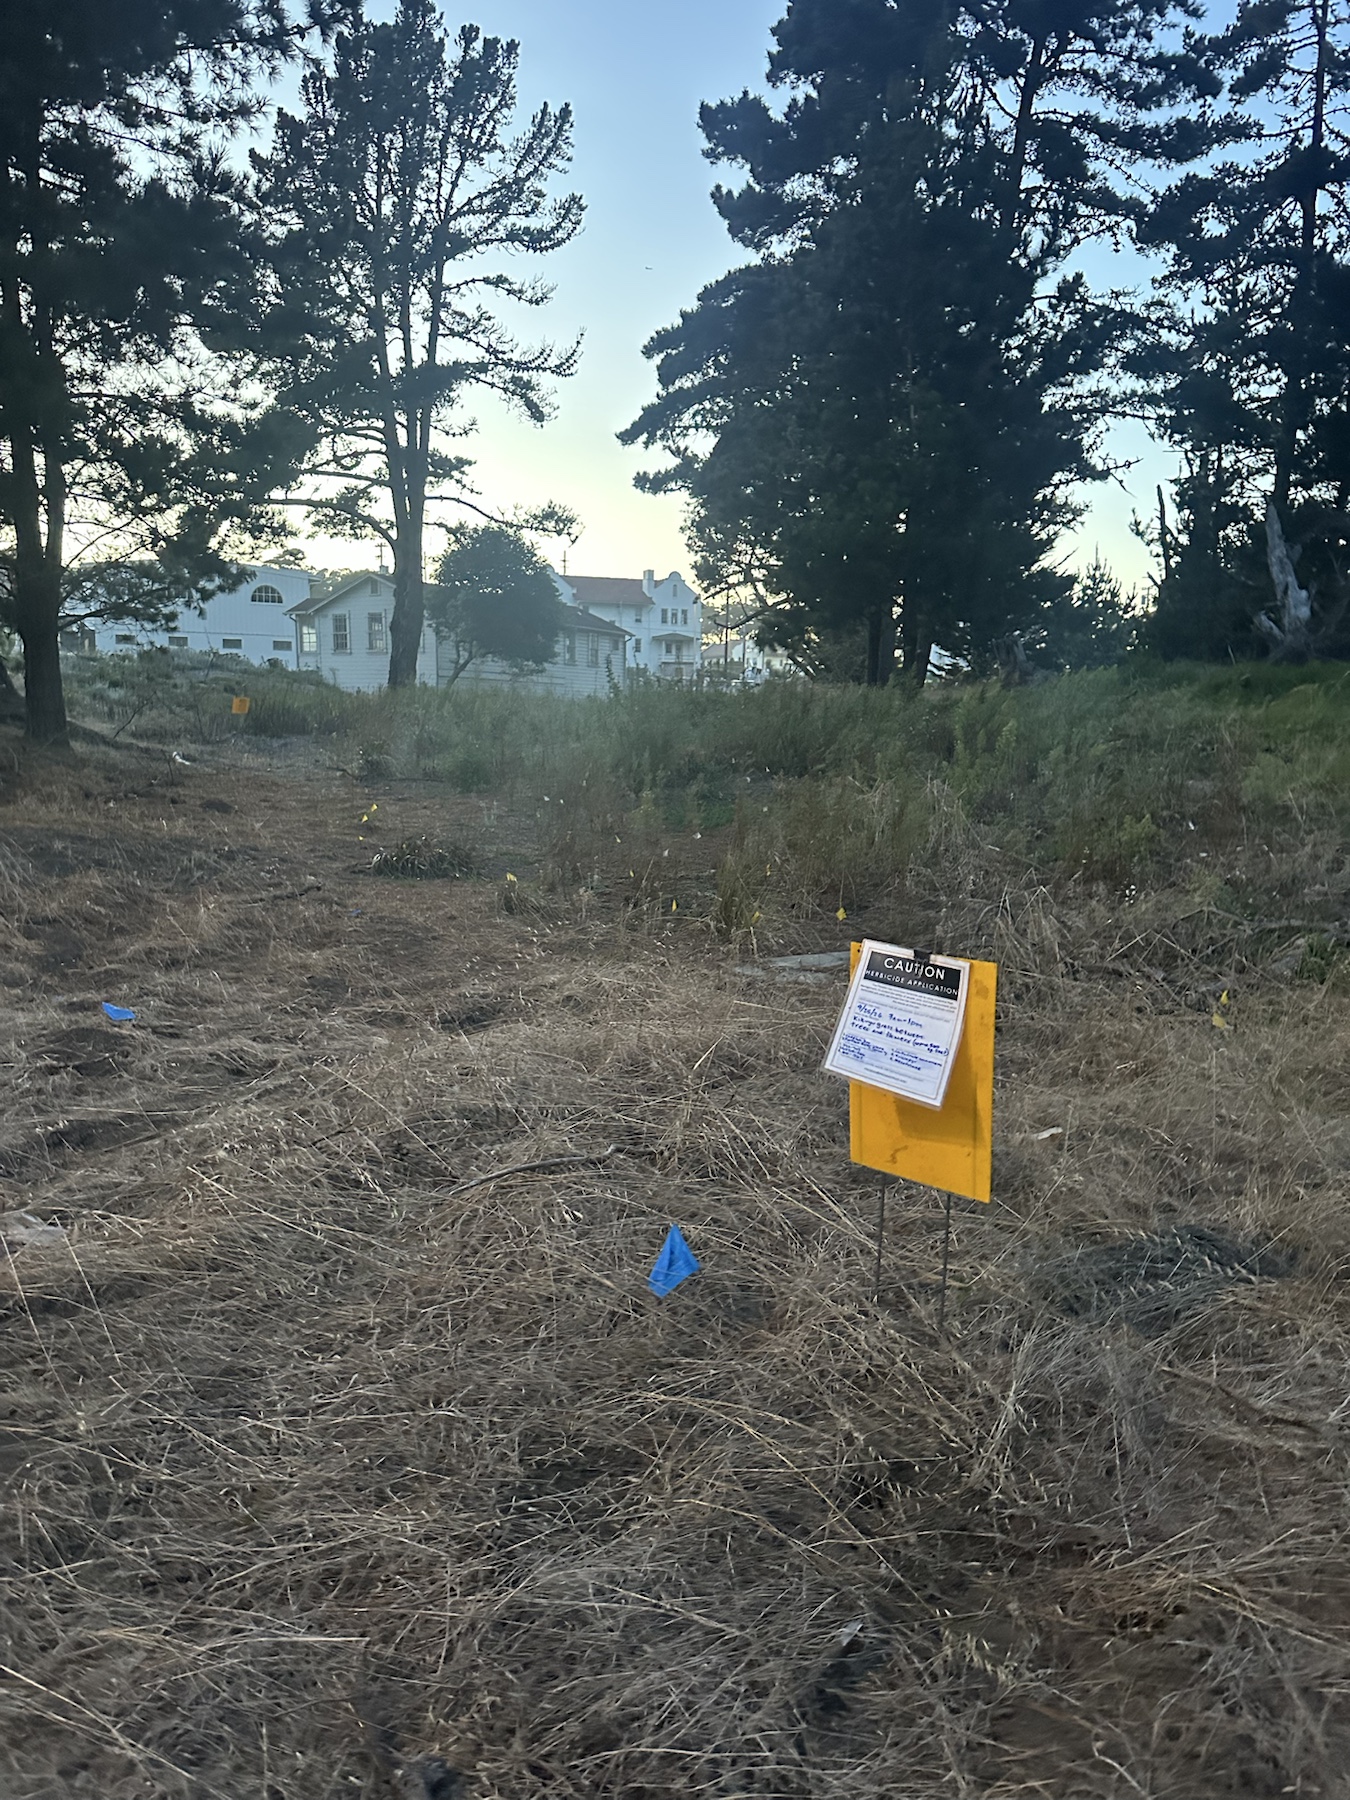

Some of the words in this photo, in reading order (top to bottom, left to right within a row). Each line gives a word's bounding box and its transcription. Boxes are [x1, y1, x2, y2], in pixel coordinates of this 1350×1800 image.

[884, 957, 945, 981] CAUTION
[865, 969, 905, 984] HERBICIDE
[907, 978, 958, 996] APPLICATION
[850, 1021, 869, 1032] trees
[894, 1025, 924, 1039] between
